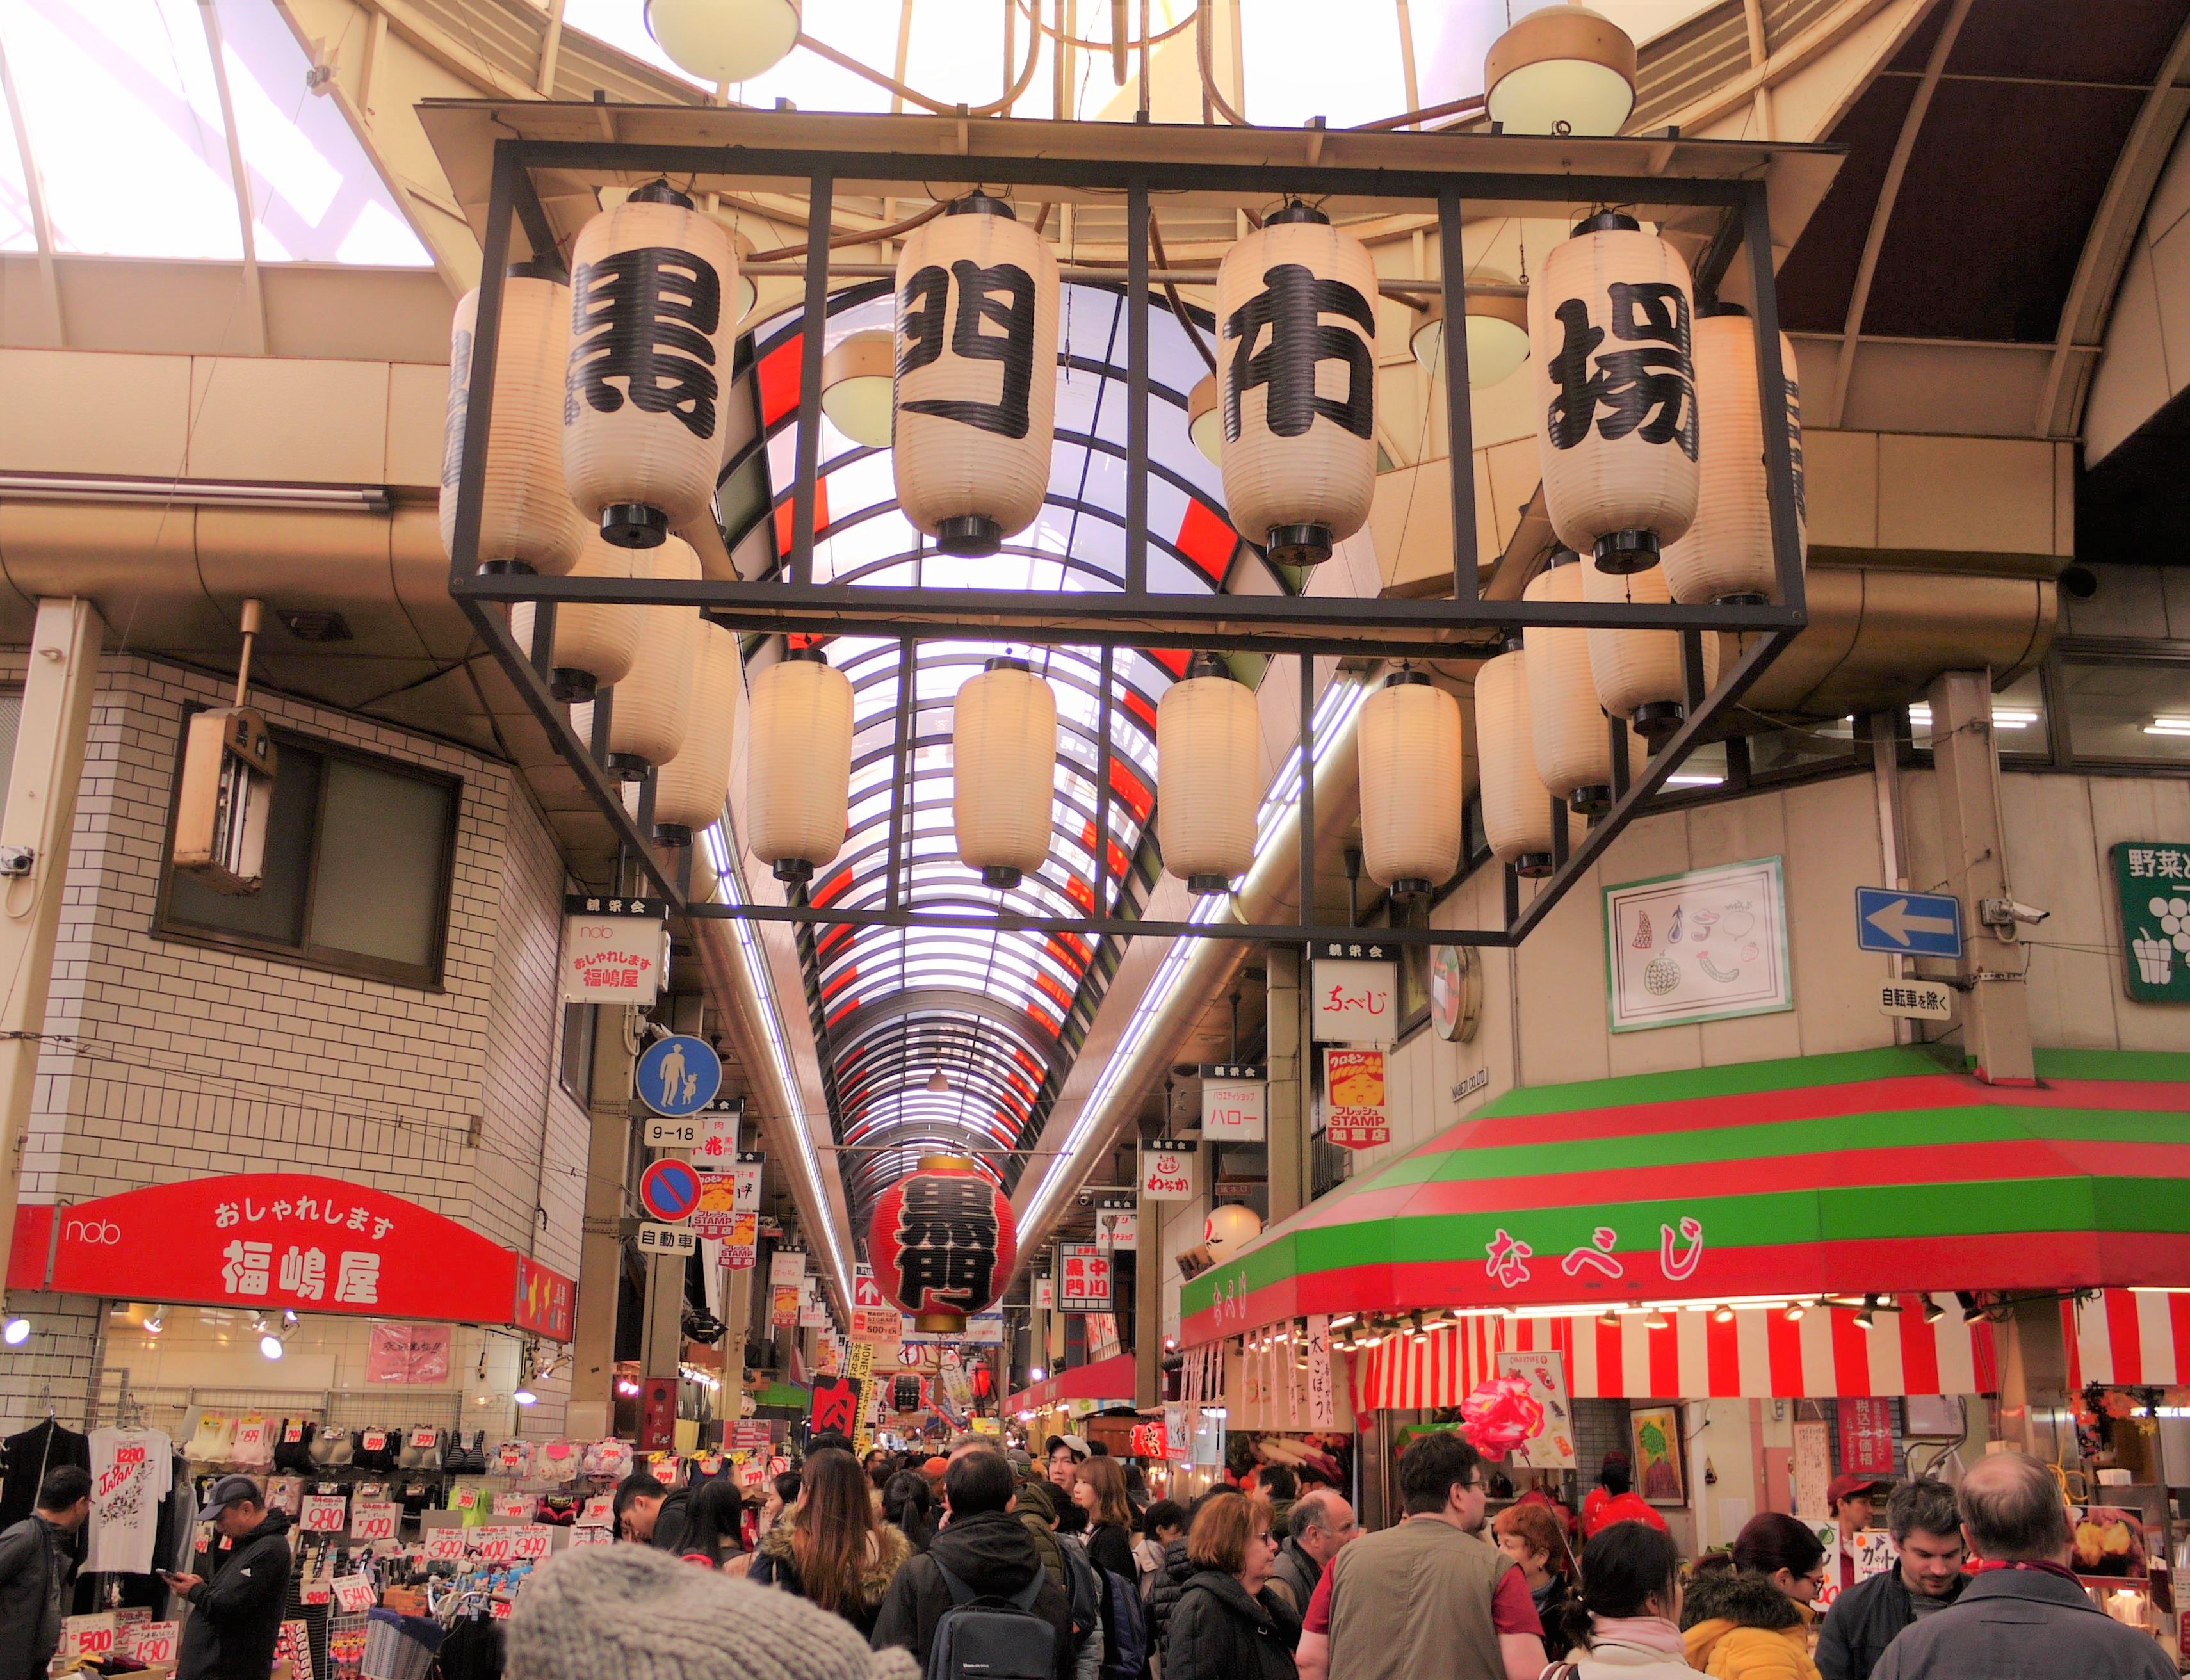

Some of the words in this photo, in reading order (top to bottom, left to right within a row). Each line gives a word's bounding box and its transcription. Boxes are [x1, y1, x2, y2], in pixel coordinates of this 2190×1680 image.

[1224, 263, 1375, 442] 市
[1548, 282, 1699, 462] 場
[580, 925, 613, 939] nob
[573, 950, 651, 971] おしゃれします
[583, 968, 638, 988] 福嶋屋
[1882, 987, 1947, 1011] 自転車を除く
[1329, 1054, 1365, 1068] クロモン
[1210, 1109, 1258, 1126] ハロー
[1331, 1116, 1386, 1127] STAMP
[1334, 1106, 1379, 1117] フレッシュ
[1331, 1129, 1386, 1142] 加盟店
[1148, 1174, 1189, 1192] わなか
[215, 1195, 394, 1240] おしゃれします
[65, 1218, 121, 1245] nob
[642, 1229, 693, 1249] 自動車
[1486, 1215, 1702, 1288] なべじ
[221, 1240, 381, 1304] 福嶋屋
[1066, 1258, 1085, 1297] 黒門
[1089, 1258, 1108, 1297] 中川
[859, 1344, 872, 1376] MONEY
[811, 1377, 859, 1437] 肉
[99, 1463, 135, 1497] JAPAN
[744, 1469, 763, 1484] 799
[308, 1508, 343, 1530] 980
[358, 1517, 391, 1538] 799
[428, 1540, 463, 1559] 399
[514, 1537, 547, 1556] 399
[342, 1585, 373, 1606] 540
[79, 1629, 113, 1654] 500
[136, 1637, 170, 1663] 130
